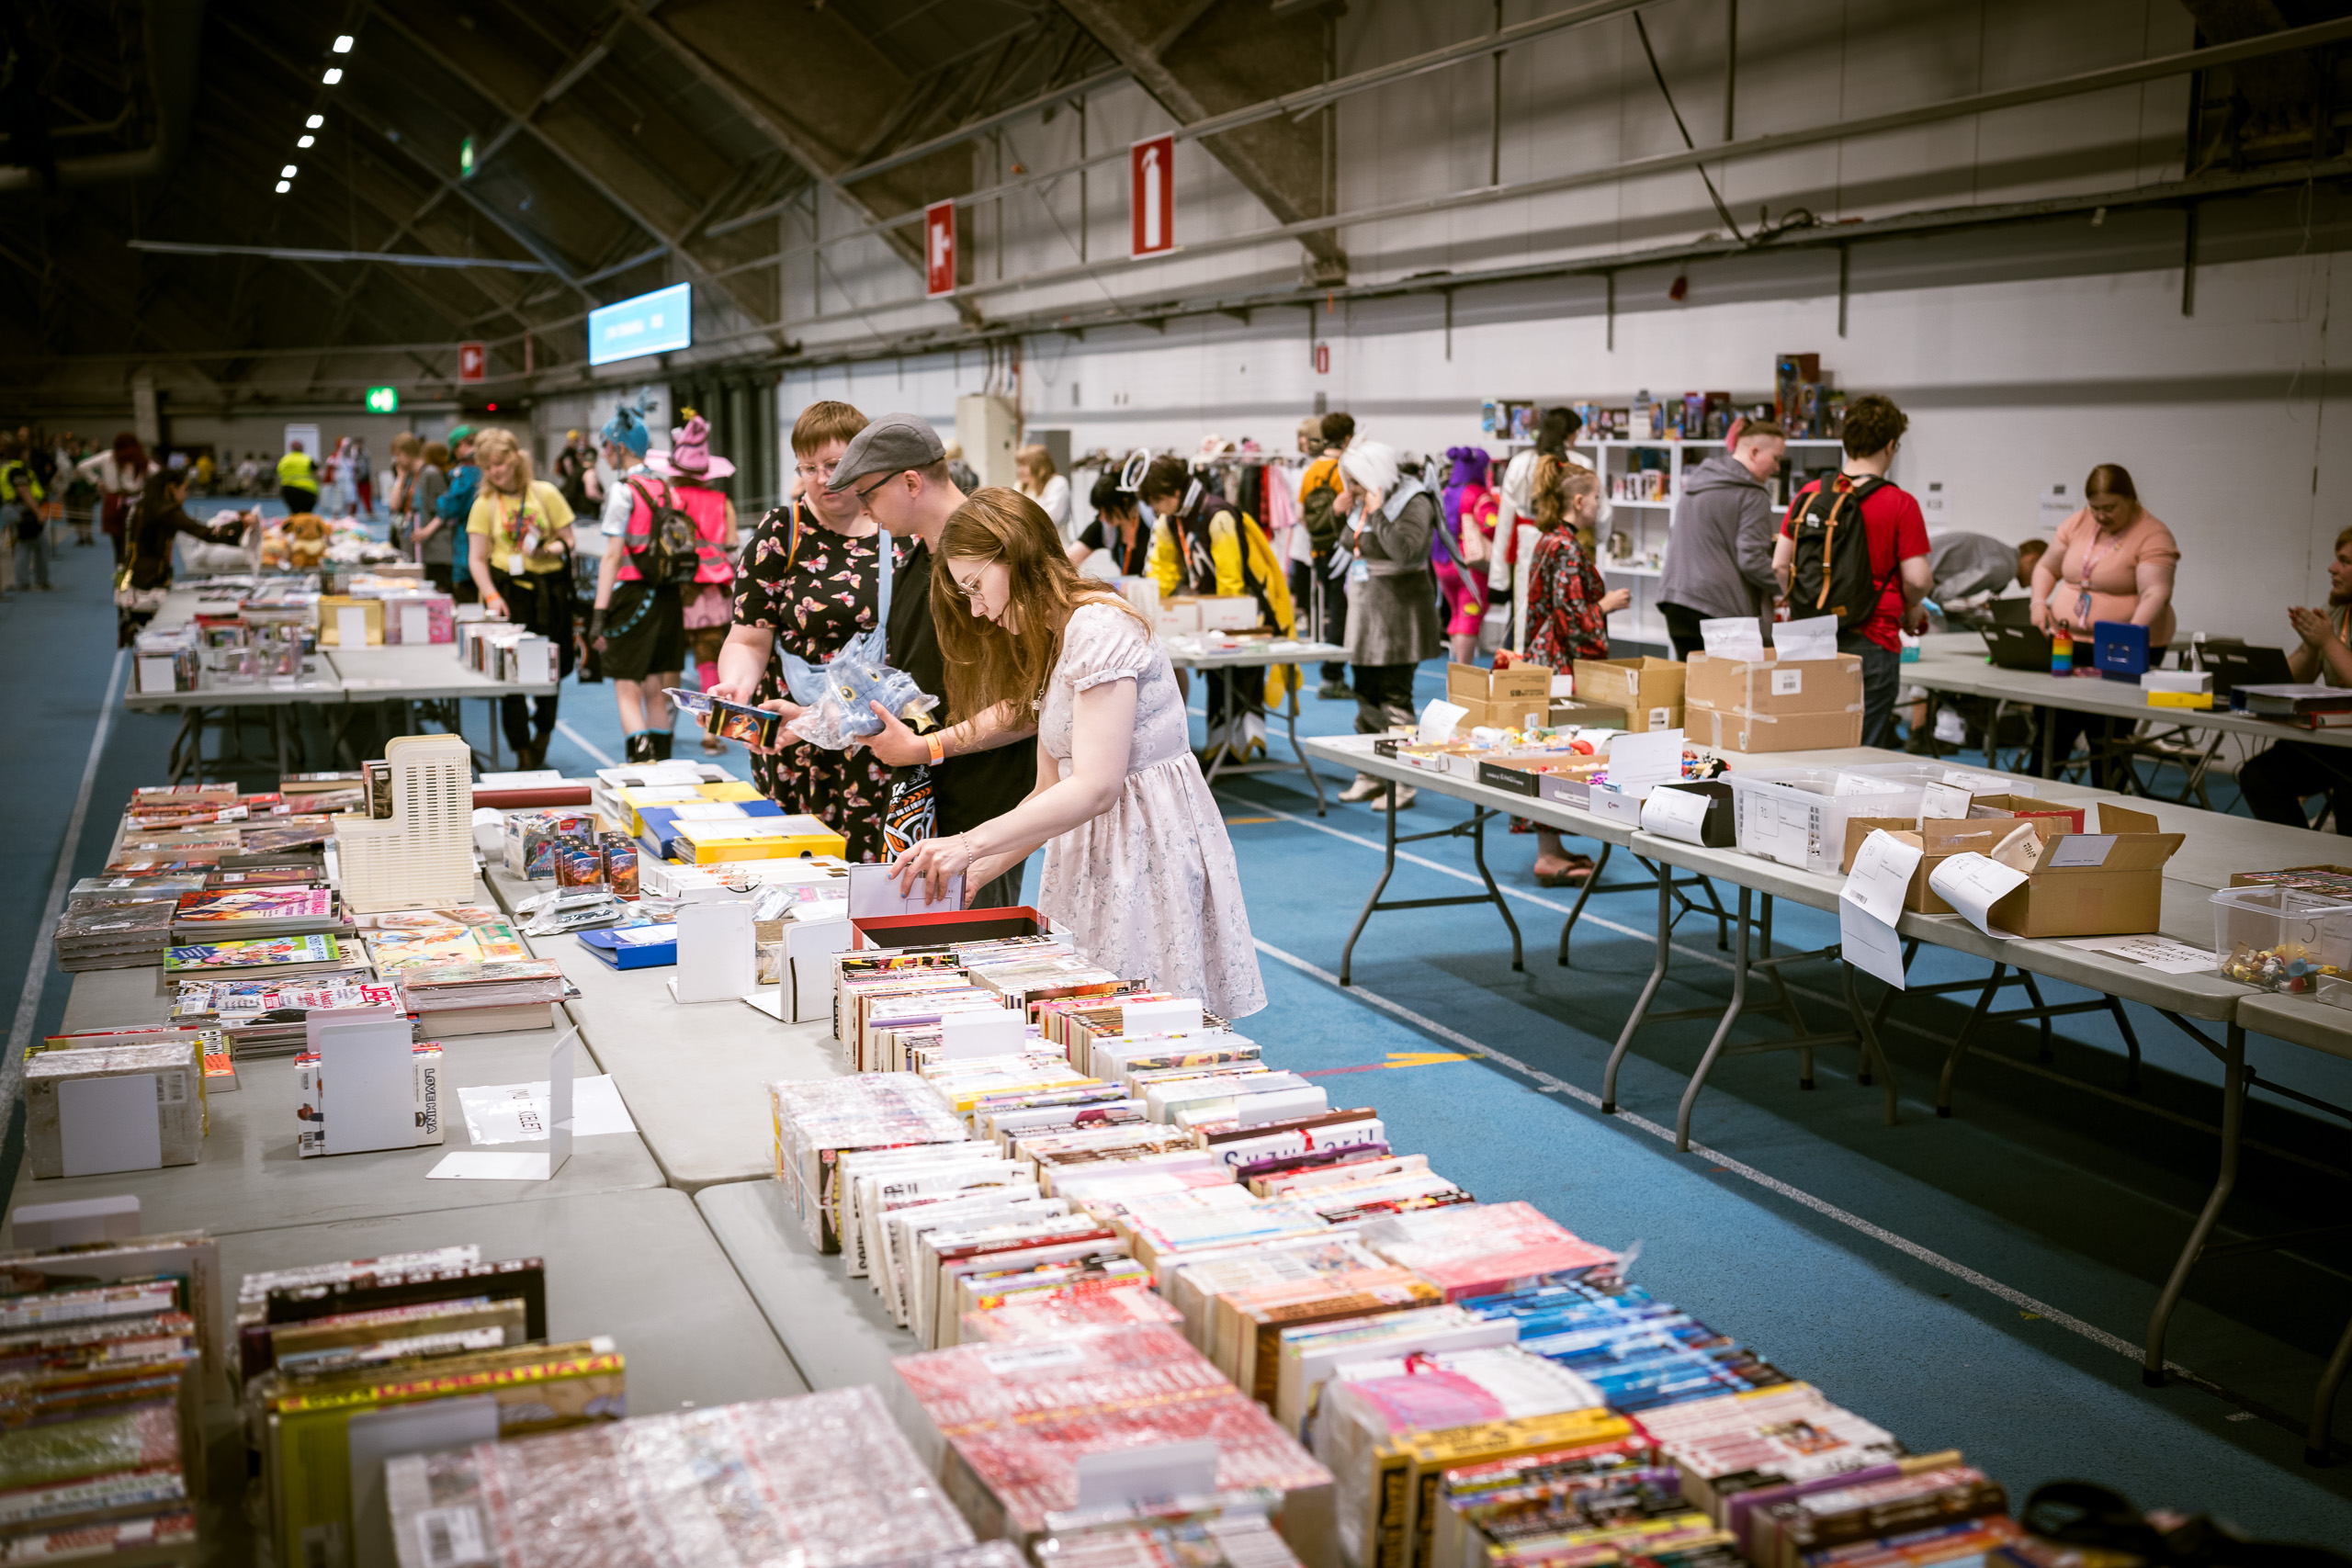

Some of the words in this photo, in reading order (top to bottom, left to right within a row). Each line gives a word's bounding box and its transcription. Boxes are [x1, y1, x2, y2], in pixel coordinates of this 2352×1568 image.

[2023, 844, 2032, 858] KITTY
[2027, 842, 2037, 858] HELLO
[424, 1068, 435, 1101] LOVE
[426, 1101, 438, 1134] HINA
